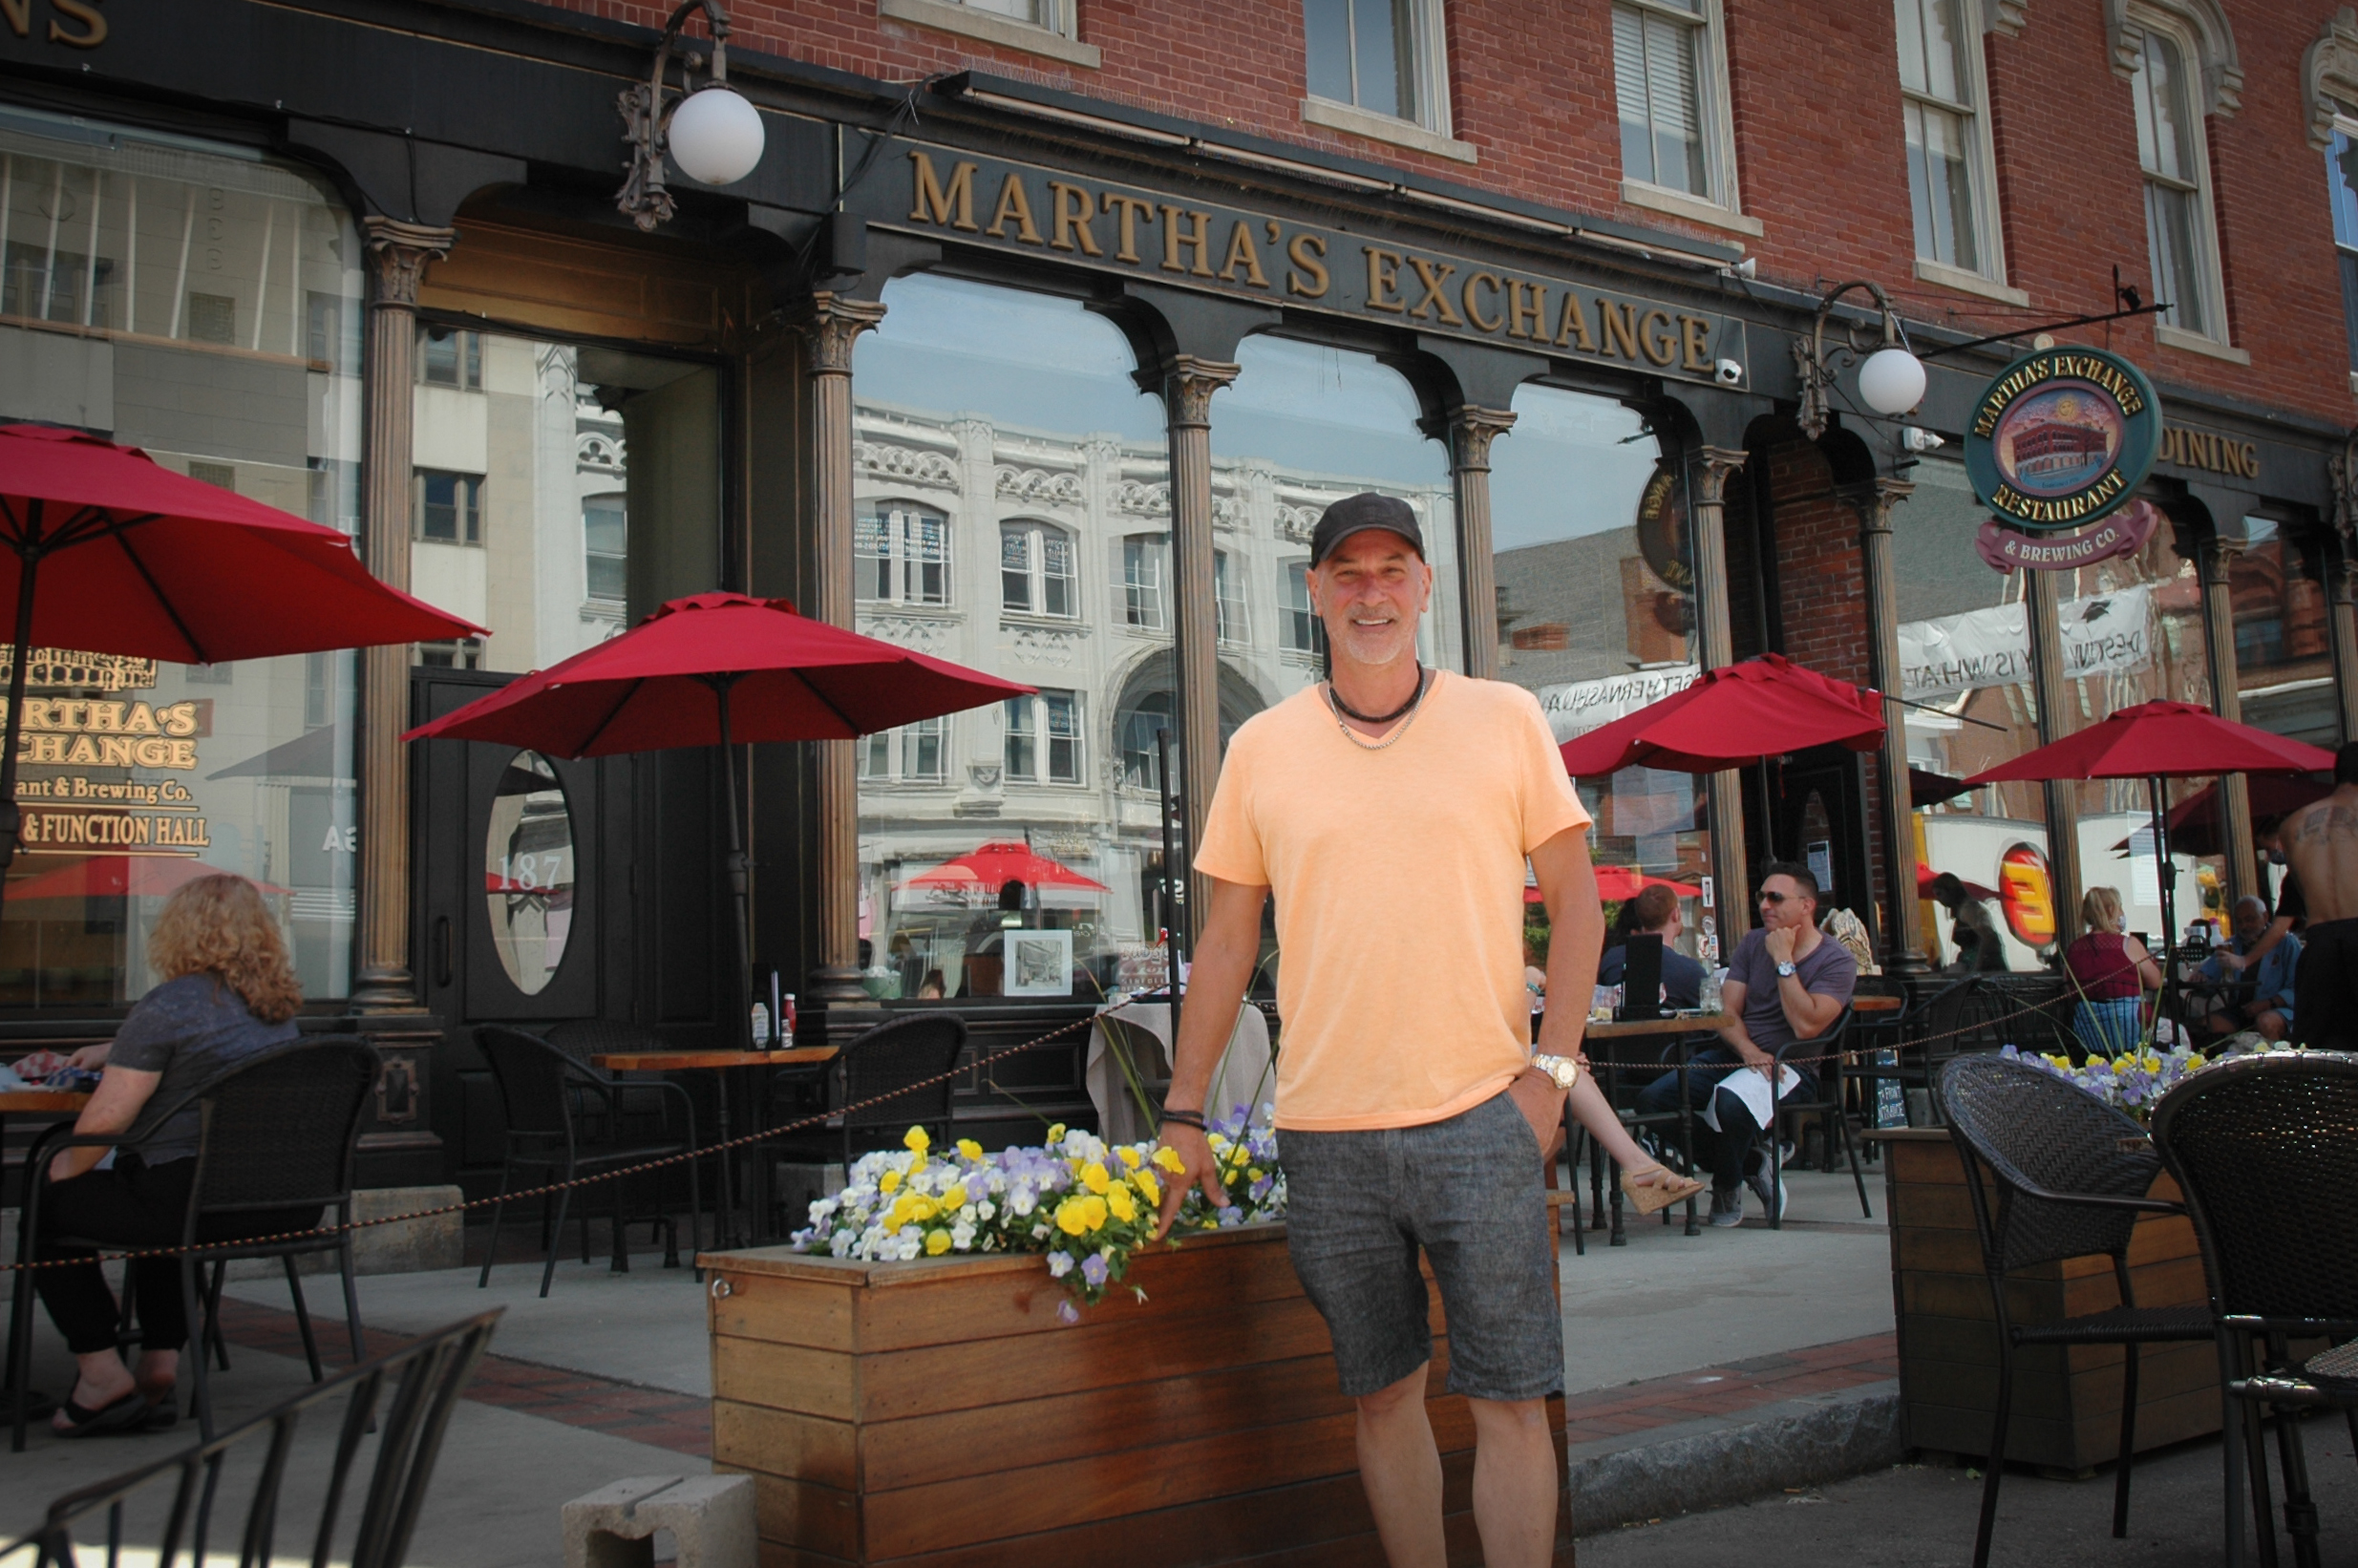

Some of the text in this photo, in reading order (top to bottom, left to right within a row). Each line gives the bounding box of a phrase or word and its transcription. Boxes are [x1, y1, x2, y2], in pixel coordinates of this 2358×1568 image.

[908, 150, 1715, 374] MARTHA'S EXCHANGE
[1973, 355, 2145, 438] MARTHA'S EXCHANGE
[2158, 426, 2260, 478] DINING
[1991, 468, 2129, 521] RESTAURANT
[2005, 527, 2120, 562] & BREWING CO.
[0, 697, 199, 736] RTHA'S
[54, 775, 70, 797] &
[73, 776, 158, 805] Brewing
[160, 779, 192, 801] Co.
[23, 813, 211, 847] & FUNCTION HALL
[498, 854, 562, 890] 187
